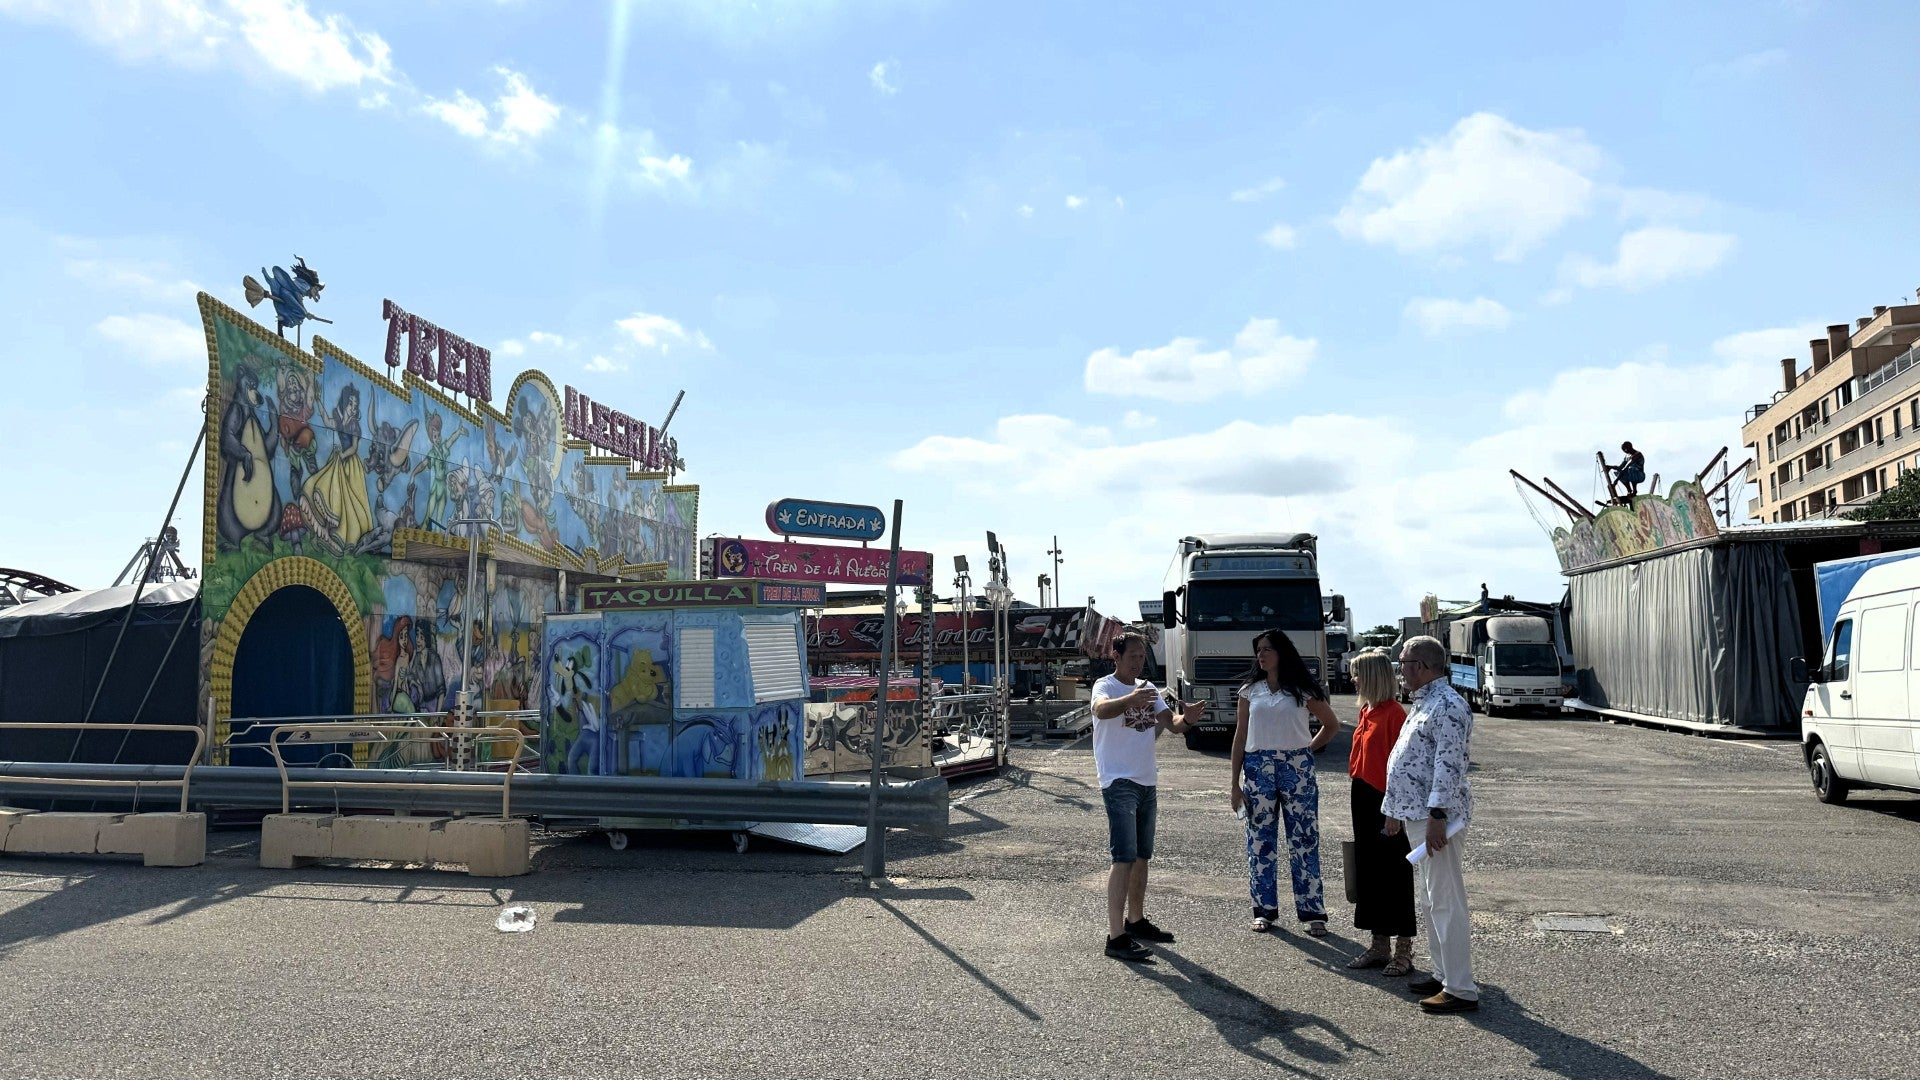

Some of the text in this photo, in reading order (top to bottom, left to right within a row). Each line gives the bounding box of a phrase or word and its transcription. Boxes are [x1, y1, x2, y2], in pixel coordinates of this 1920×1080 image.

[383, 298, 492, 403] TREN
[565, 384, 662, 471] ALEGRIA
[796, 508, 867, 531] ENTRADA
[762, 552, 890, 578] TREN DE LA ALEGRI
[588, 585, 747, 606] TAQUILLA
